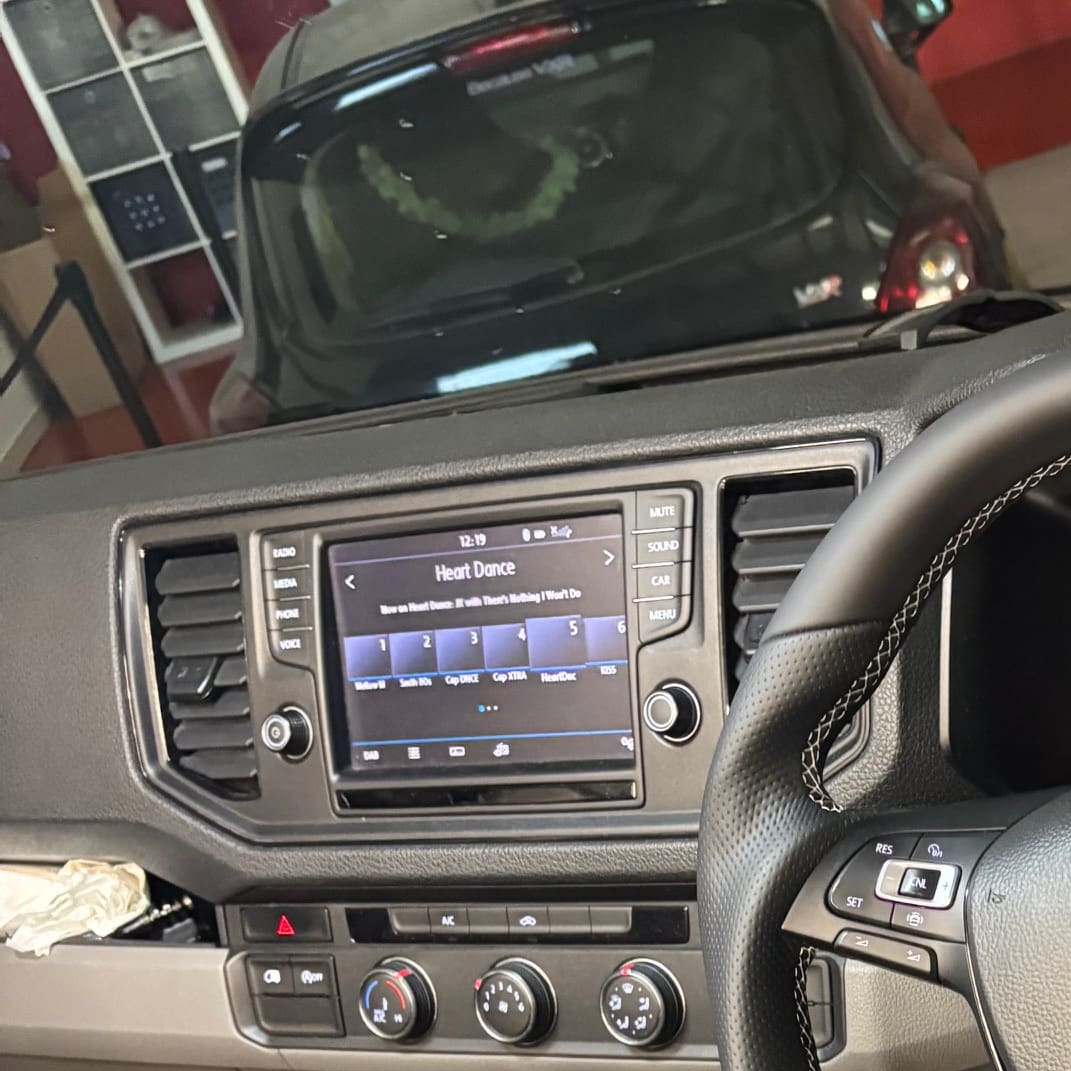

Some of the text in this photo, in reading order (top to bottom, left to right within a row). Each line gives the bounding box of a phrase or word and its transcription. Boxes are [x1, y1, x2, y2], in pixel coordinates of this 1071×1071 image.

[650, 506, 676, 518] MUTE
[459, 533, 487, 547] 12:19
[273, 547, 296, 558] RADIO
[648, 540, 679, 553] SOUND
[435, 560, 516, 581] Heart Dance
[273, 578, 297, 589] MEDIA
[651, 575, 671, 586] CAR
[275, 608, 299, 620] PHONE
[649, 609, 676, 621] MENU
[569, 620, 578, 636] 5
[617, 621, 626, 634] 6
[470, 631, 478, 645] 3
[518, 628, 526, 641] 4
[280, 639, 301, 650] VOICE
[379, 639, 386, 651] 1
[423, 635, 431, 648] 2
[876, 843, 894, 855] RES
[846, 896, 864, 908] SET
